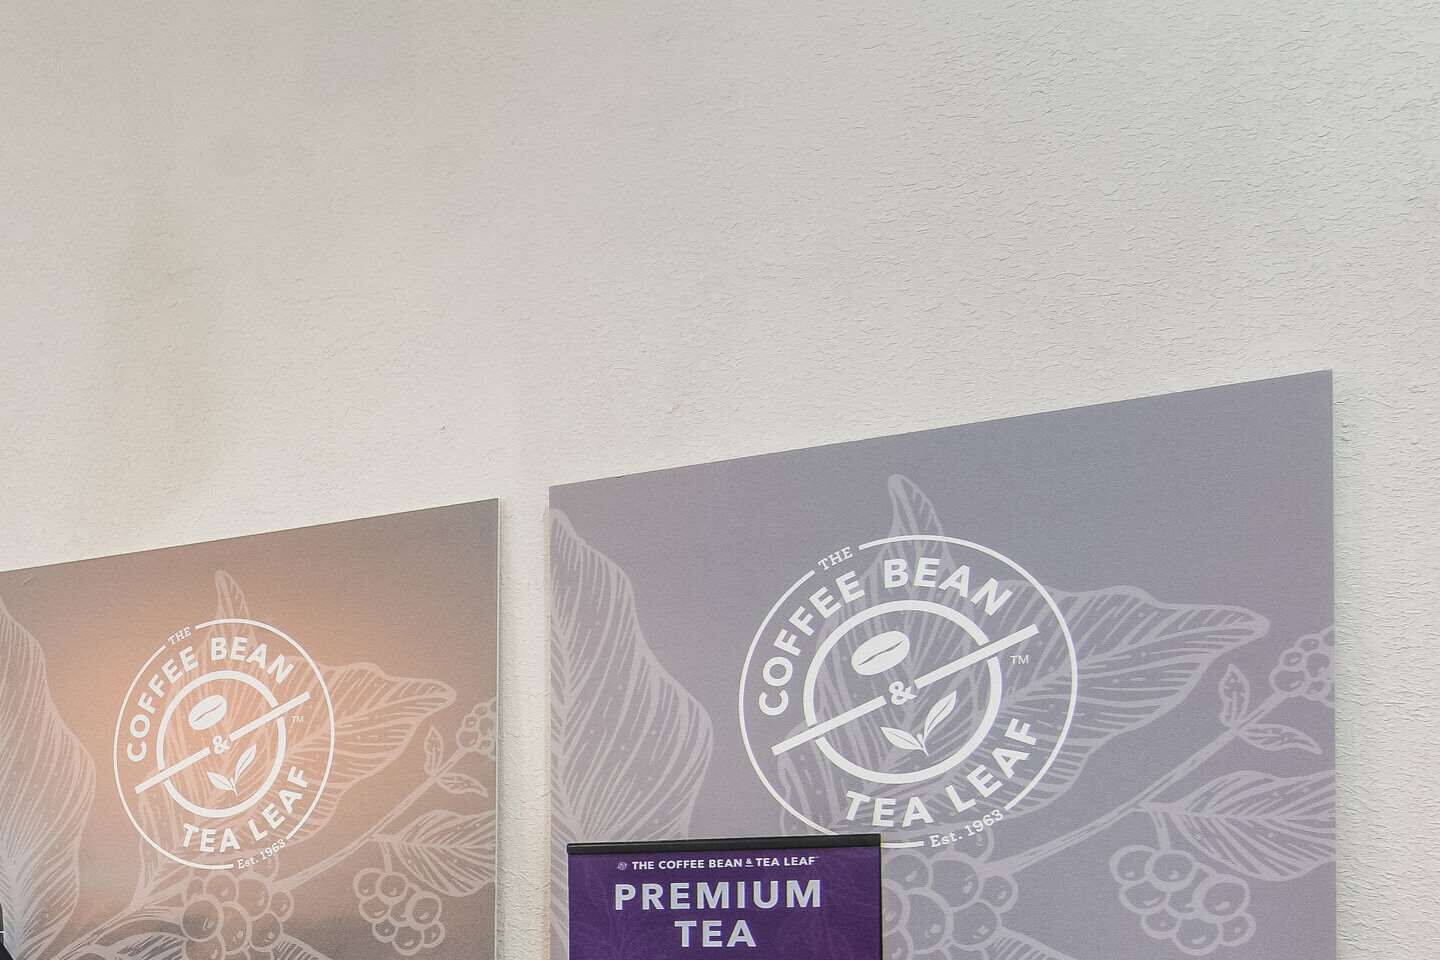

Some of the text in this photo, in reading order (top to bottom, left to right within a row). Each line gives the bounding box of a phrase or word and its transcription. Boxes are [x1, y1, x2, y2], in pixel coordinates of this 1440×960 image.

[818, 546, 853, 572] THE
[167, 627, 192, 645] THE
[758, 557, 1013, 716] COFFEE BEAN
[127, 636, 294, 762] COFFEE BEAN
[889, 681, 917, 705] &
[212, 735, 231, 755] &
[846, 718, 1037, 827] TEA LEAF
[183, 766, 310, 853] TEA LEAF
[965, 809, 1004, 835] 1963
[260, 839, 287, 860] 1963
[632, 856, 815, 870] THE COFFEE BEAN & TEA LEAF
[615, 880, 821, 911] PREMIUM
[674, 919, 756, 948] TEA
